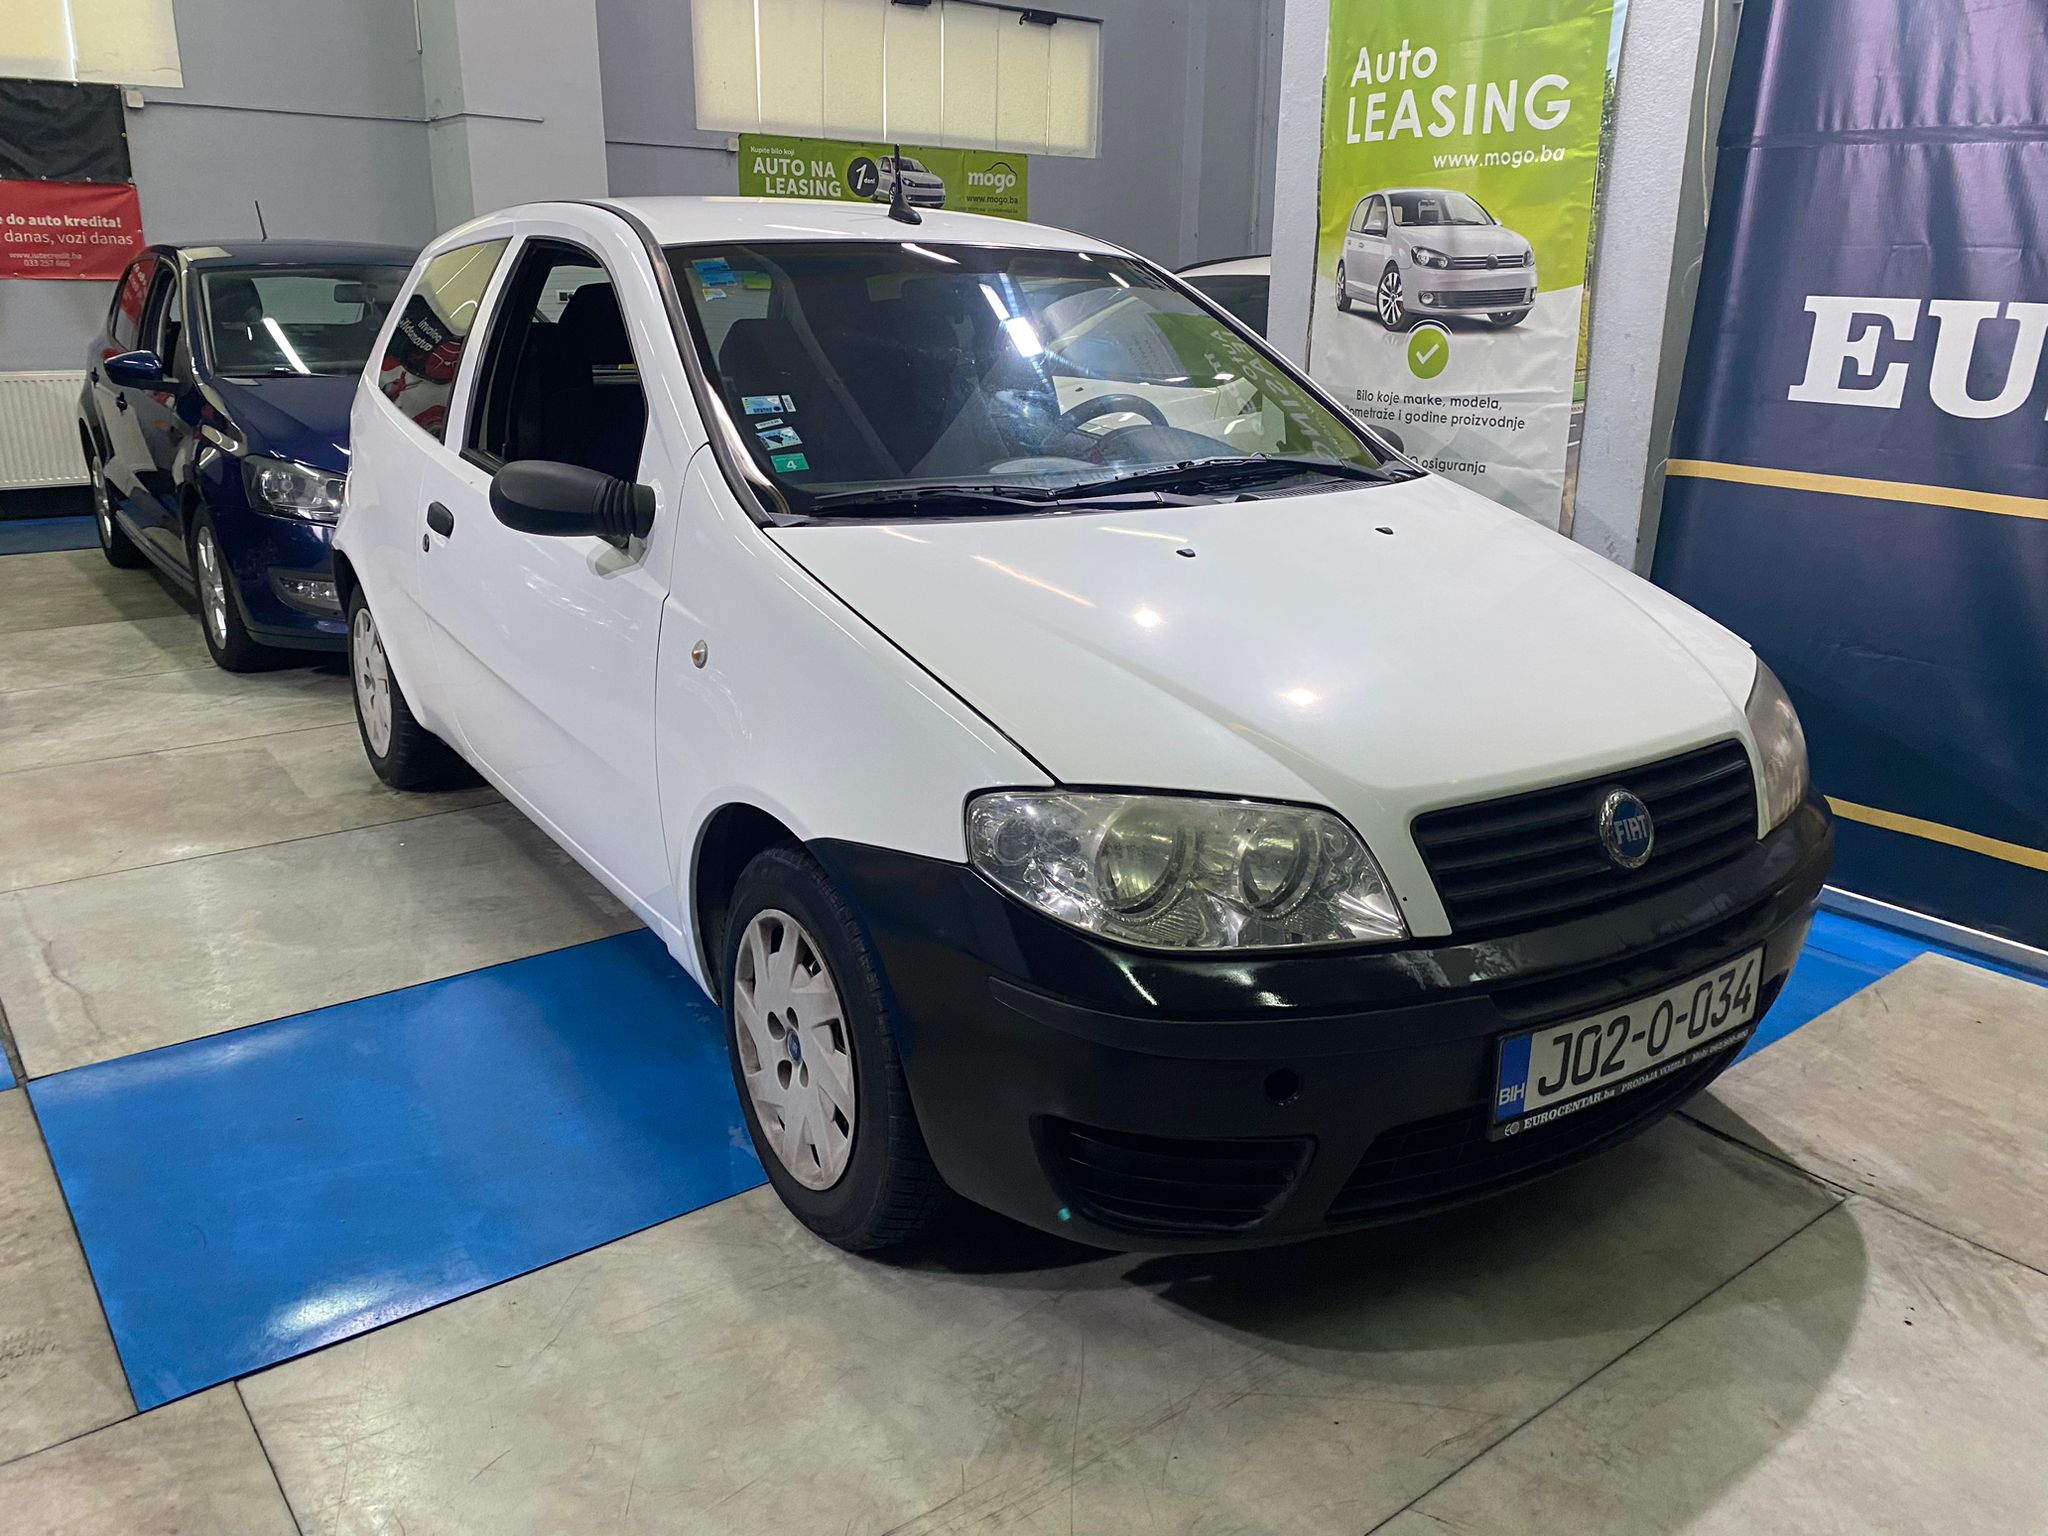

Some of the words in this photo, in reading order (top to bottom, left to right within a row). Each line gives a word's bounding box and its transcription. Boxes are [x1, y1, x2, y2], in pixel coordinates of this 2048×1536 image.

[1350, 39, 1438, 88] Auto
[1346, 74, 1571, 145] LEASING
[750, 146, 770, 154] Kupite
[1433, 145, 1565, 168] www.mogo.ba
[753, 157, 805, 176] AUTO
[811, 161, 836, 178] NA
[856, 164, 867, 190] 1
[765, 177, 841, 197] LEASING
[968, 171, 1017, 193] mogo
[966, 196, 1018, 204] www.mogo.ba
[6, 214, 25, 225] do
[28, 215, 62, 226] auto
[64, 215, 122, 228] kredita!
[4, 229, 54, 245] danas,
[56, 231, 86, 244] vozi
[90, 232, 134, 245] danas
[1356, 389, 1374, 402] Bilo
[1377, 391, 1400, 405] koje
[1403, 393, 1446, 407] marke,
[1450, 396, 1502, 411] modela,
[1398, 409, 1402, 421] i
[1405, 410, 1448, 425] godine
[1450, 413, 1525, 432] proizvodnje
[1421, 457, 1486, 476] osiguranja
[1613, 815, 1648, 845] FIAT
[1498, 1083, 1525, 1106] BIH
[1523, 1089, 1615, 1130] EUROCENTAR.ba
